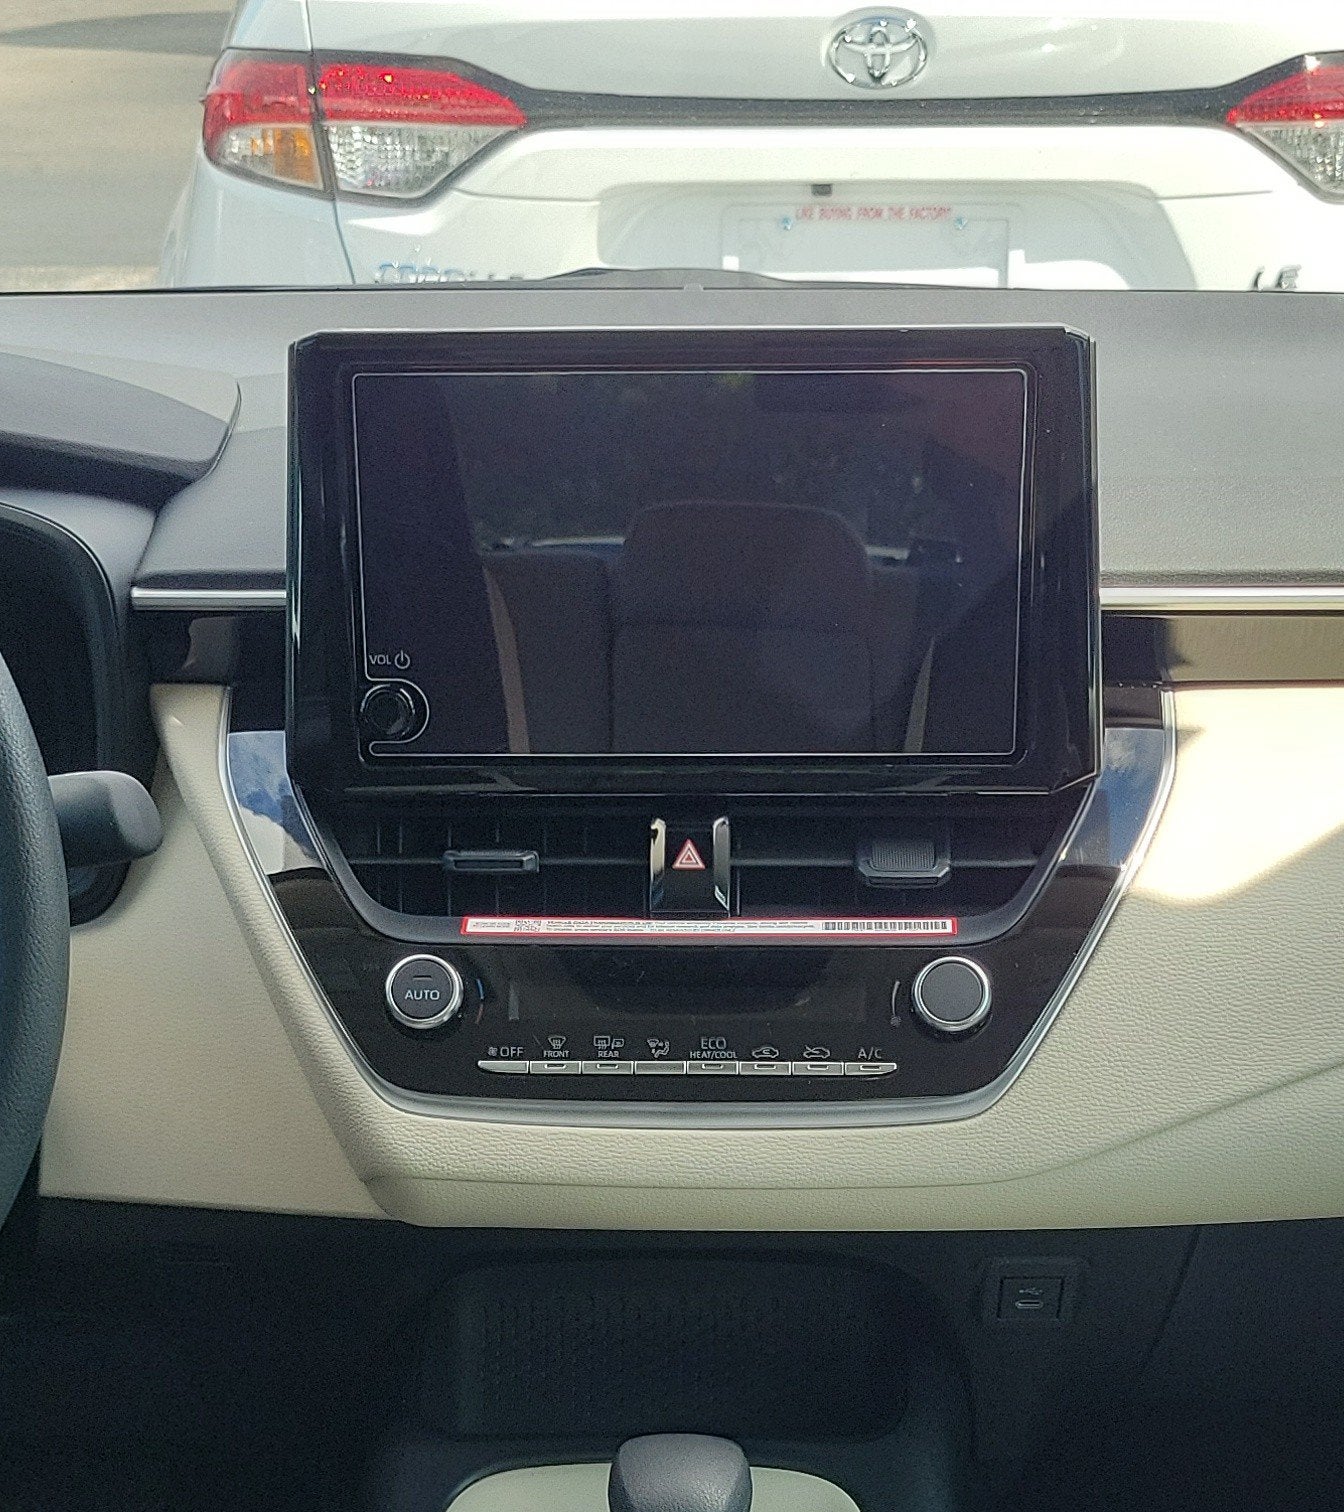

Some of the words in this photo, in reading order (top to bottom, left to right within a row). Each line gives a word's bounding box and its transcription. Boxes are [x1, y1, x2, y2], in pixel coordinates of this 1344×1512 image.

[819, 204, 852, 220] BUYING
[858, 205, 883, 219] FROM
[888, 205, 905, 220] THE
[910, 204, 951, 219] FACTORY
[369, 654, 392, 665] VOL
[404, 989, 441, 1001] AUTO
[701, 1037, 726, 1049] ECO
[500, 1047, 524, 1058] OFF
[543, 1050, 570, 1058] FRONT
[598, 1050, 620, 1058] REAR
[689, 1051, 737, 1060] HEAT/COOL
[858, 1048, 883, 1060] A/C
